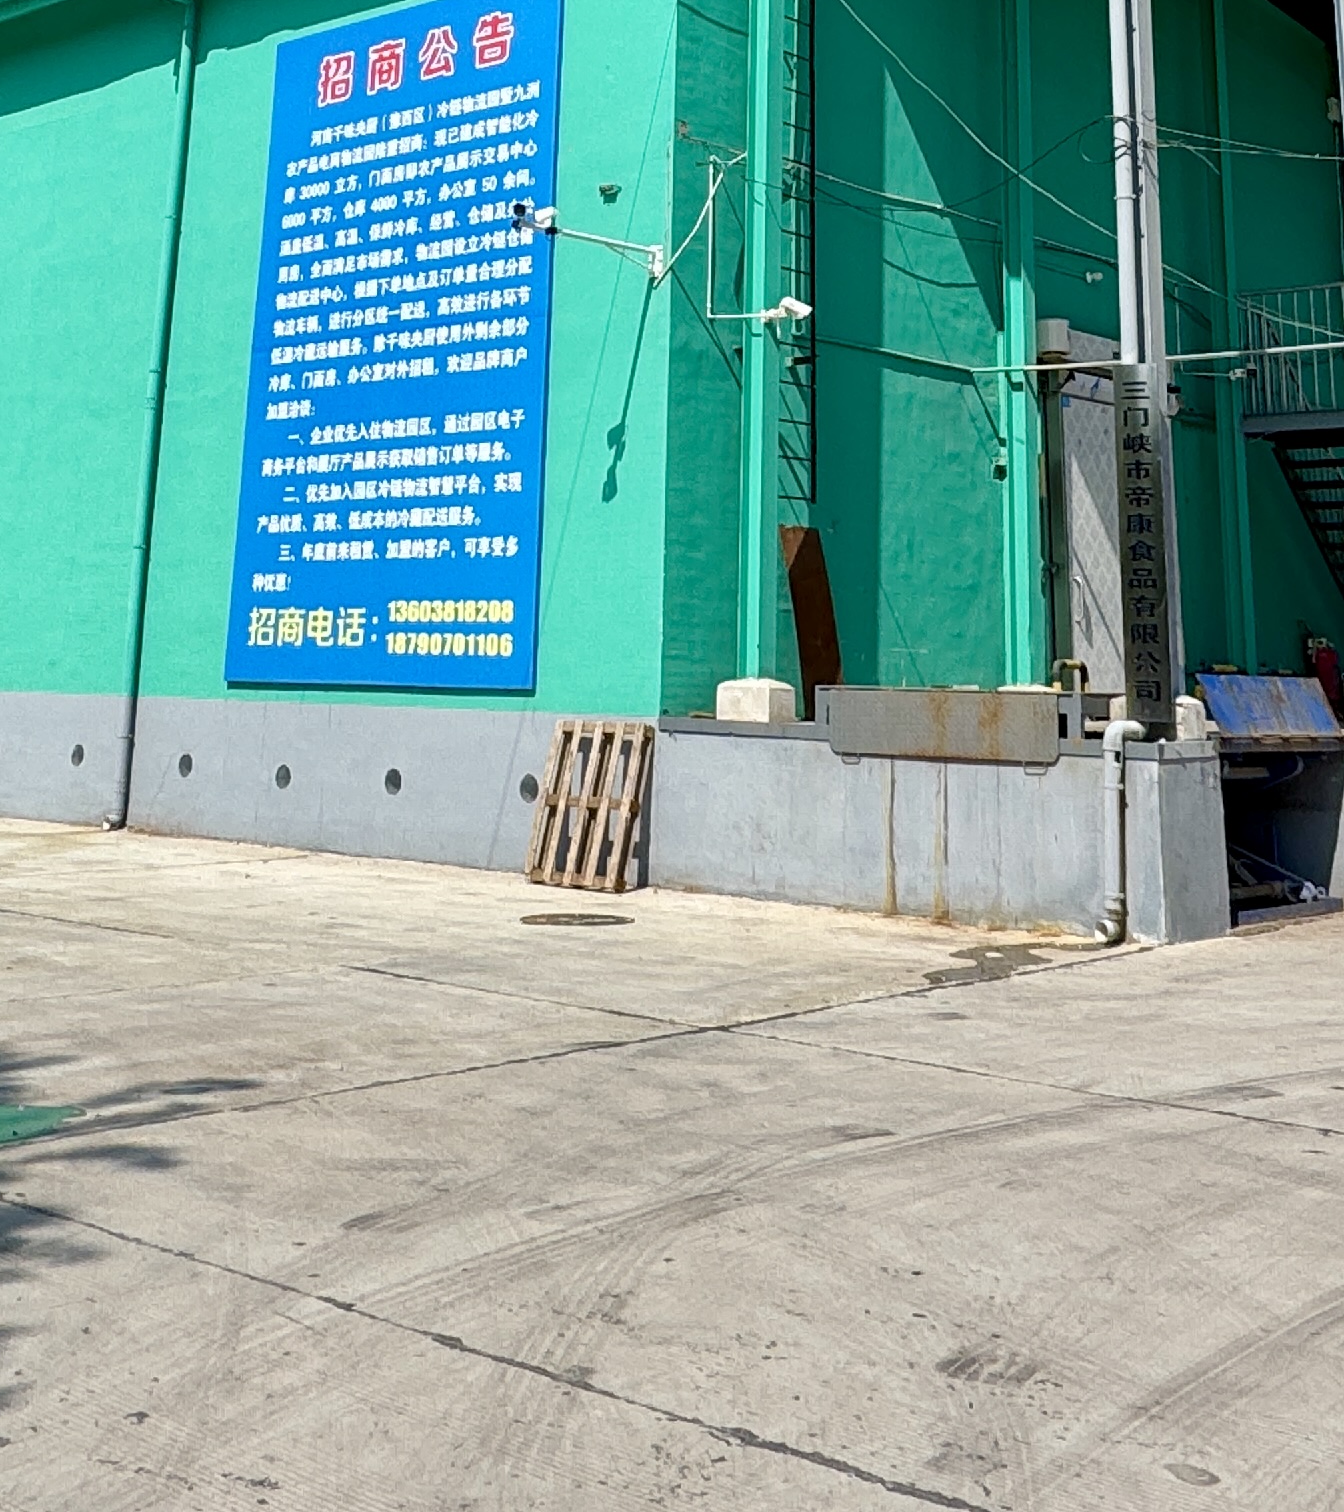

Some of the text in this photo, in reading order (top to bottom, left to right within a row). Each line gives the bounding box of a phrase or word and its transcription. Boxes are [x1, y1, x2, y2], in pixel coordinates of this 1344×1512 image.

[318, 11, 514, 107] 招商公告
[1120, 380, 1162, 703] 三门峡市帝康食品有限公司
[388, 600, 514, 623] 13603818208
[385, 632, 513, 657] 18790701106
